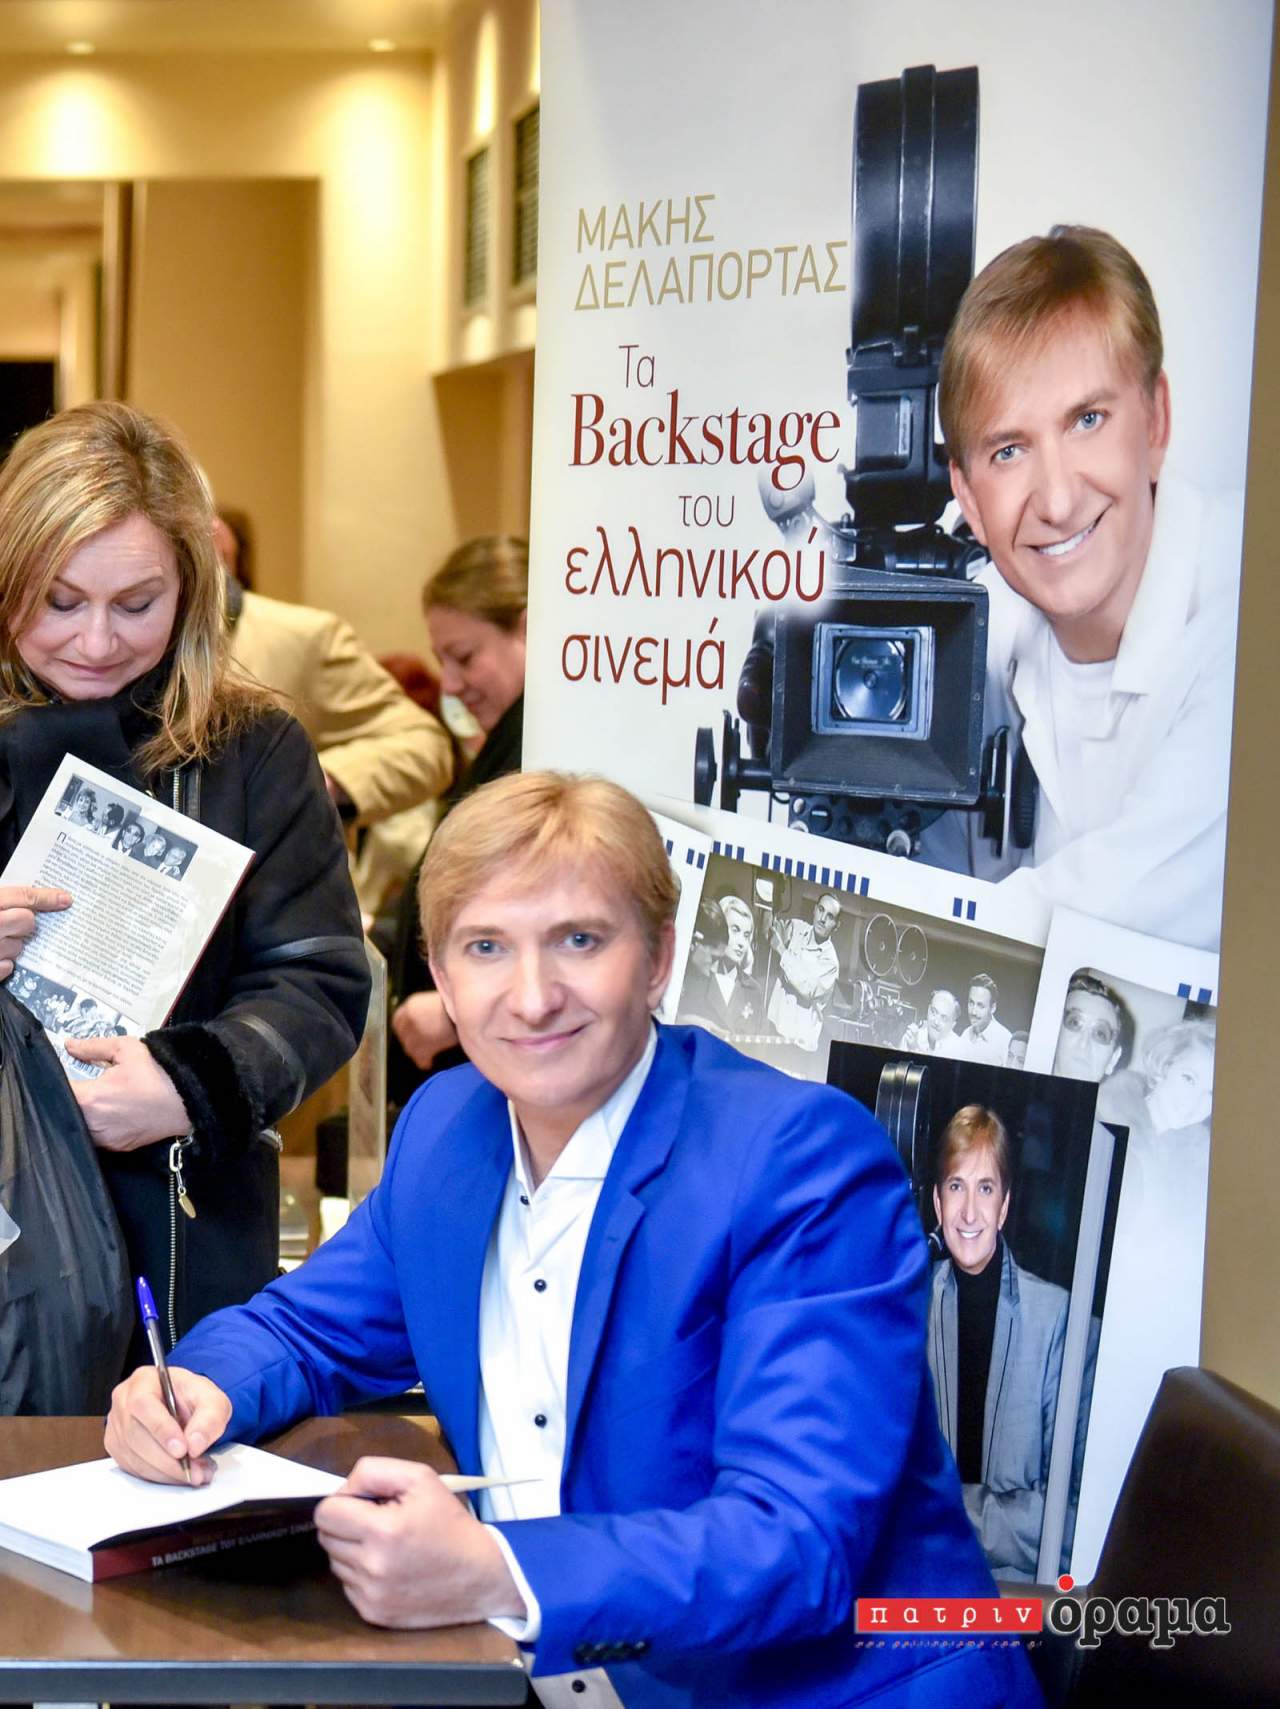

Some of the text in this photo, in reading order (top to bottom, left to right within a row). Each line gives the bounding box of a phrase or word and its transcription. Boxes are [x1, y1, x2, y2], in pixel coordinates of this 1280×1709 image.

[577, 194, 716, 253] ΜΑΚΗΣ
[574, 240, 849, 311] ΔΕΛΑΠΟΡΤΑΣ
[618, 344, 655, 388] Τα
[568, 388, 841, 491] Backstage
[678, 494, 736, 527] του
[565, 526, 826, 603] ελληνικού
[561, 616, 726, 706] σινεμά
